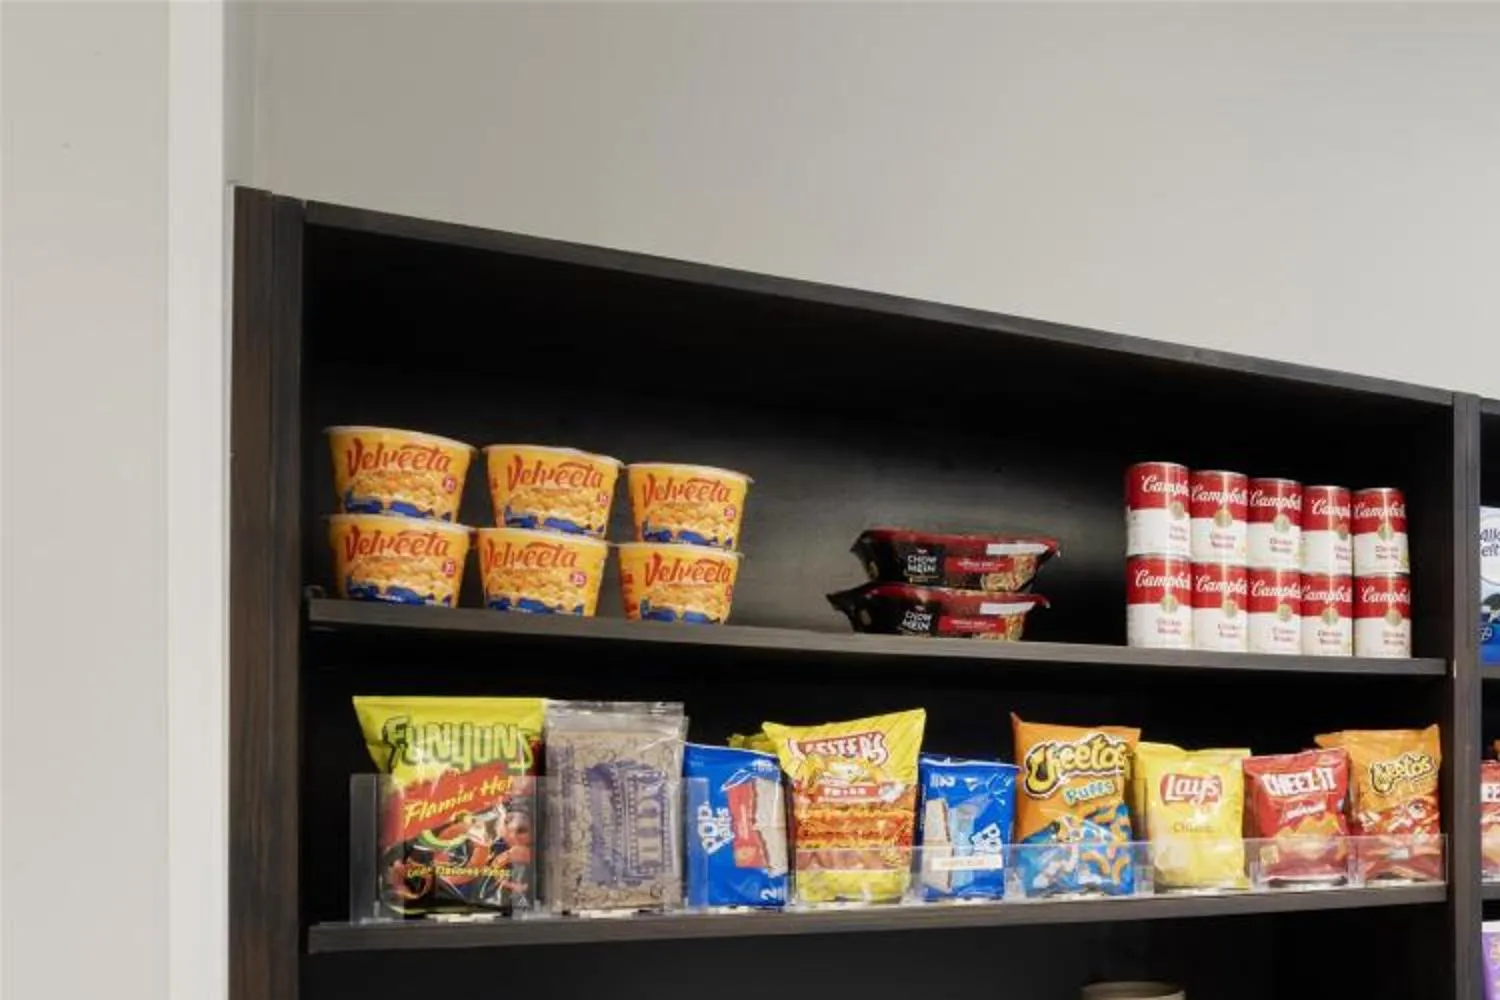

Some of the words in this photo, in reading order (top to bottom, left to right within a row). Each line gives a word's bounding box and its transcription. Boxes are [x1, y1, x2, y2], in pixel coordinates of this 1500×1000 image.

[346, 437, 452, 479] Velveeta
[507, 454, 605, 492] Velveeta
[643, 472, 732, 507] Velveeta
[345, 525, 450, 563] Velveeta
[484, 538, 577, 574] Velveeta
[645, 552, 731, 587] Velveeta
[1162, 774, 1221, 805] Lay's
